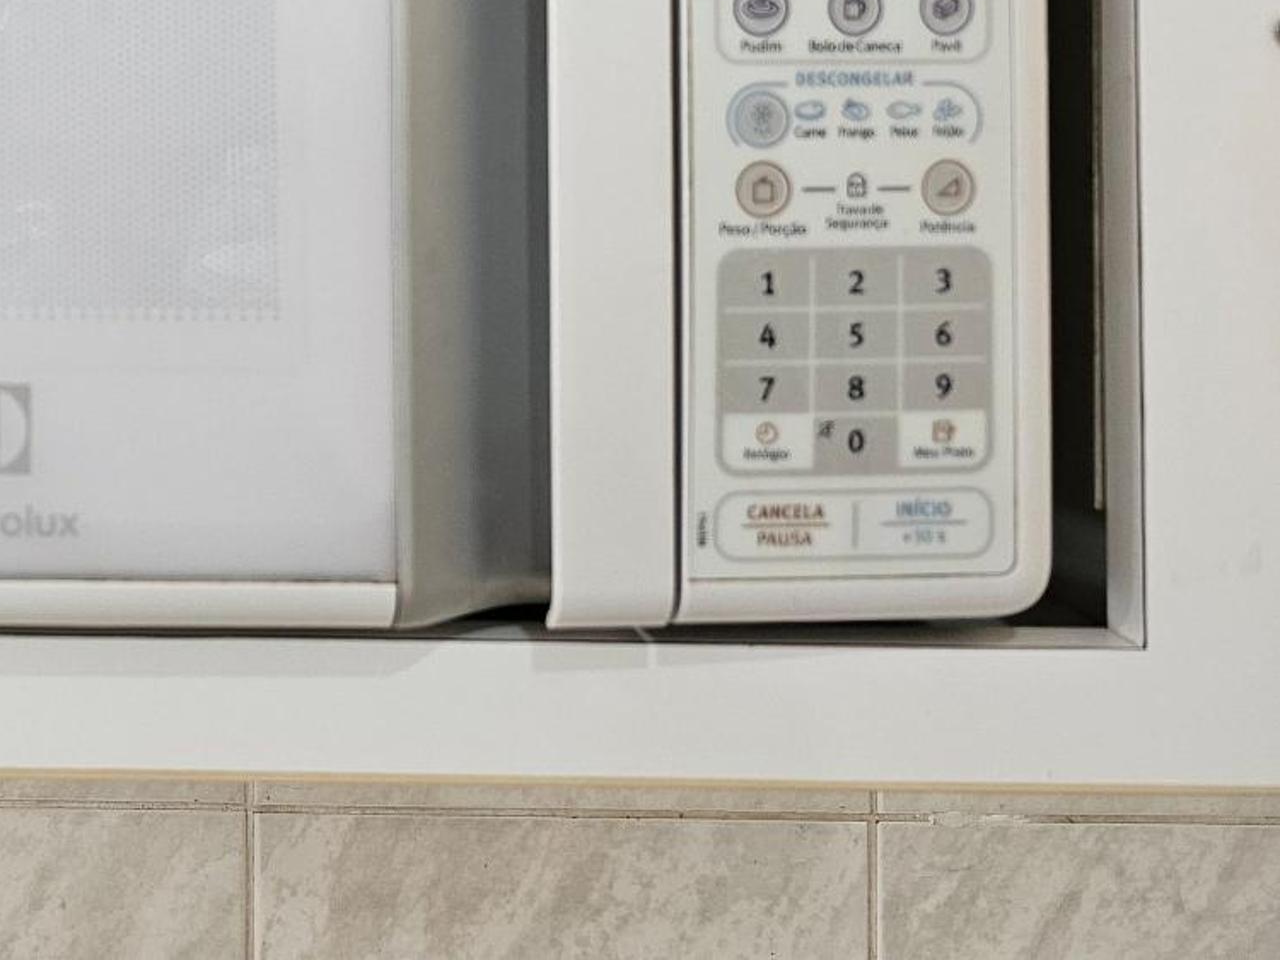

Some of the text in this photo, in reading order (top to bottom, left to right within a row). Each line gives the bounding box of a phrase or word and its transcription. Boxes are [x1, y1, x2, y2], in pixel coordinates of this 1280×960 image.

[740, 41, 782, 54] Pudim
[795, 70, 914, 87] DESCONGELAR
[760, 271, 775, 295] 1
[847, 269, 864, 295] 2
[935, 268, 952, 293] 3
[758, 323, 776, 349] 4
[848, 322, 864, 348] 5
[934, 321, 952, 346] 6
[759, 376, 775, 402] 7
[847, 375, 865, 401] 8
[934, 373, 952, 399] 9
[847, 428, 865, 454] 0
[746, 503, 825, 520] CANCELA
[755, 530, 812, 546] PAUSA
